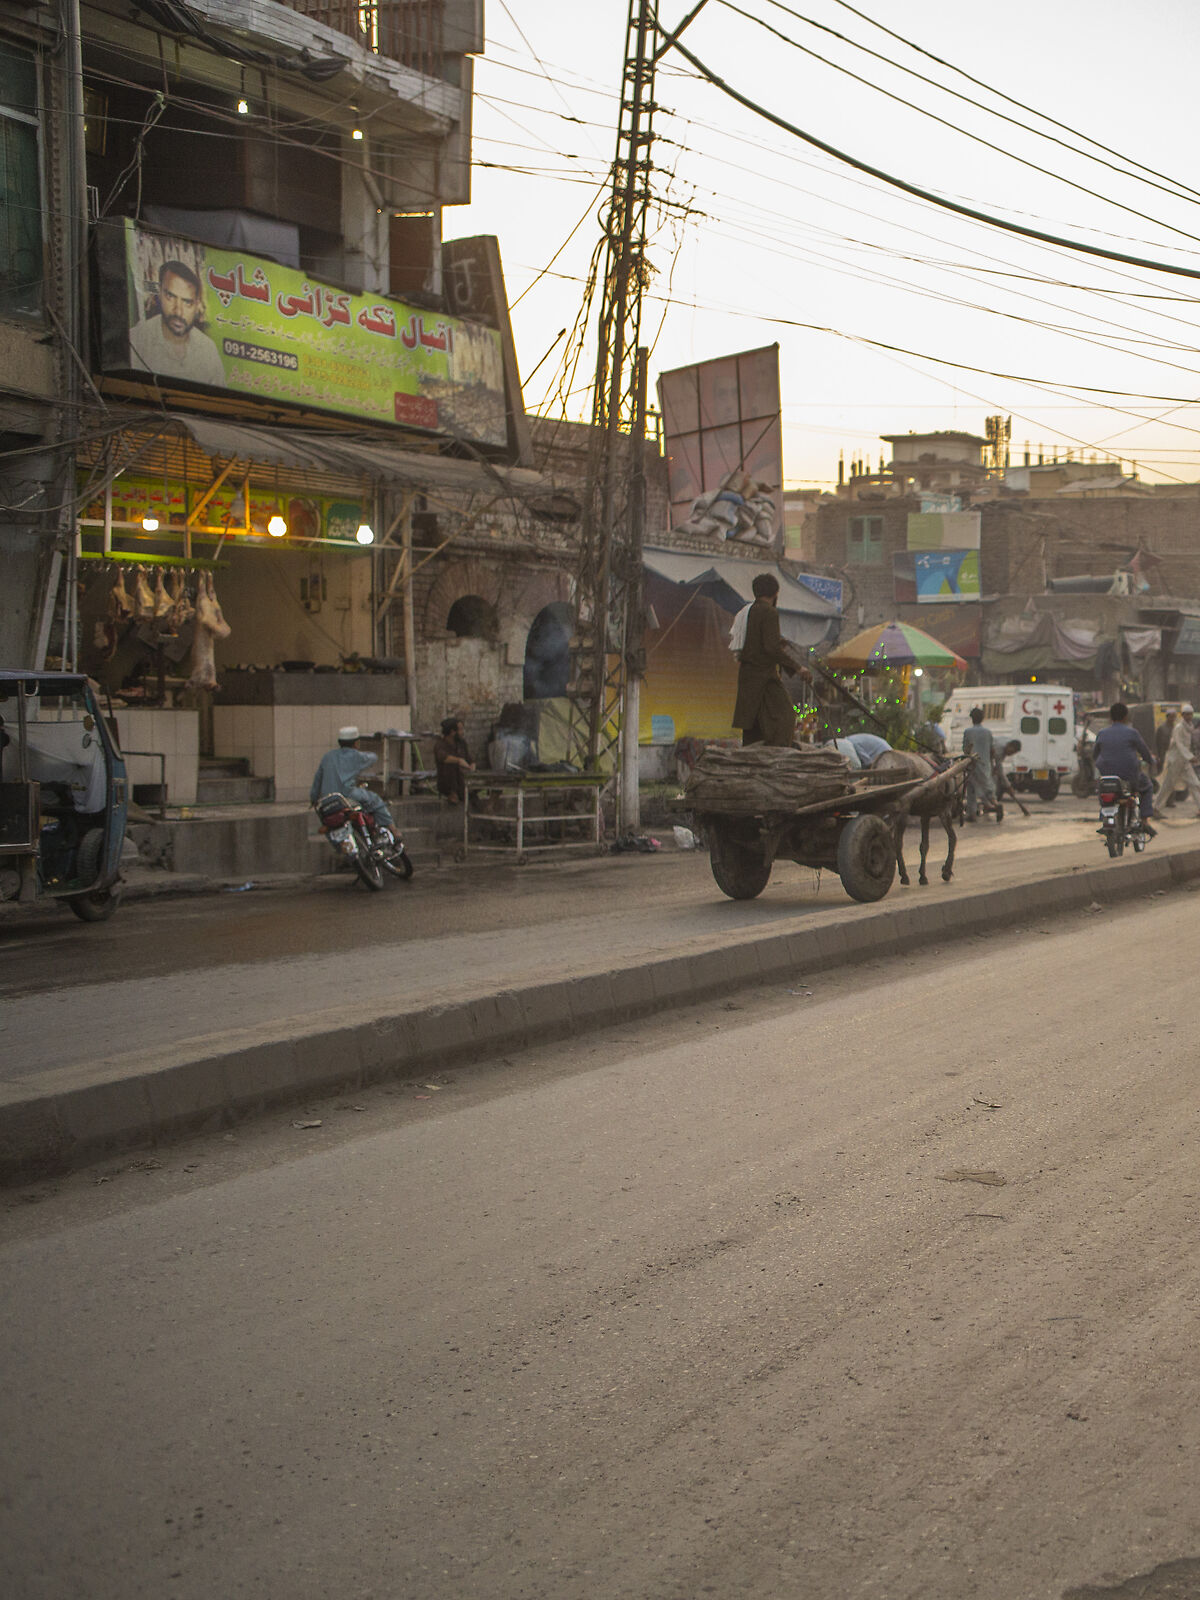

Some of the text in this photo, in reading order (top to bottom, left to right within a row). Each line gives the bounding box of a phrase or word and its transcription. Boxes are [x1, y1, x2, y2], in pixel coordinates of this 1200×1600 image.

[207, 262, 455, 355] اقبال تکہ کڑائی شاپ
[225, 340, 298, 369] 091-2563196
